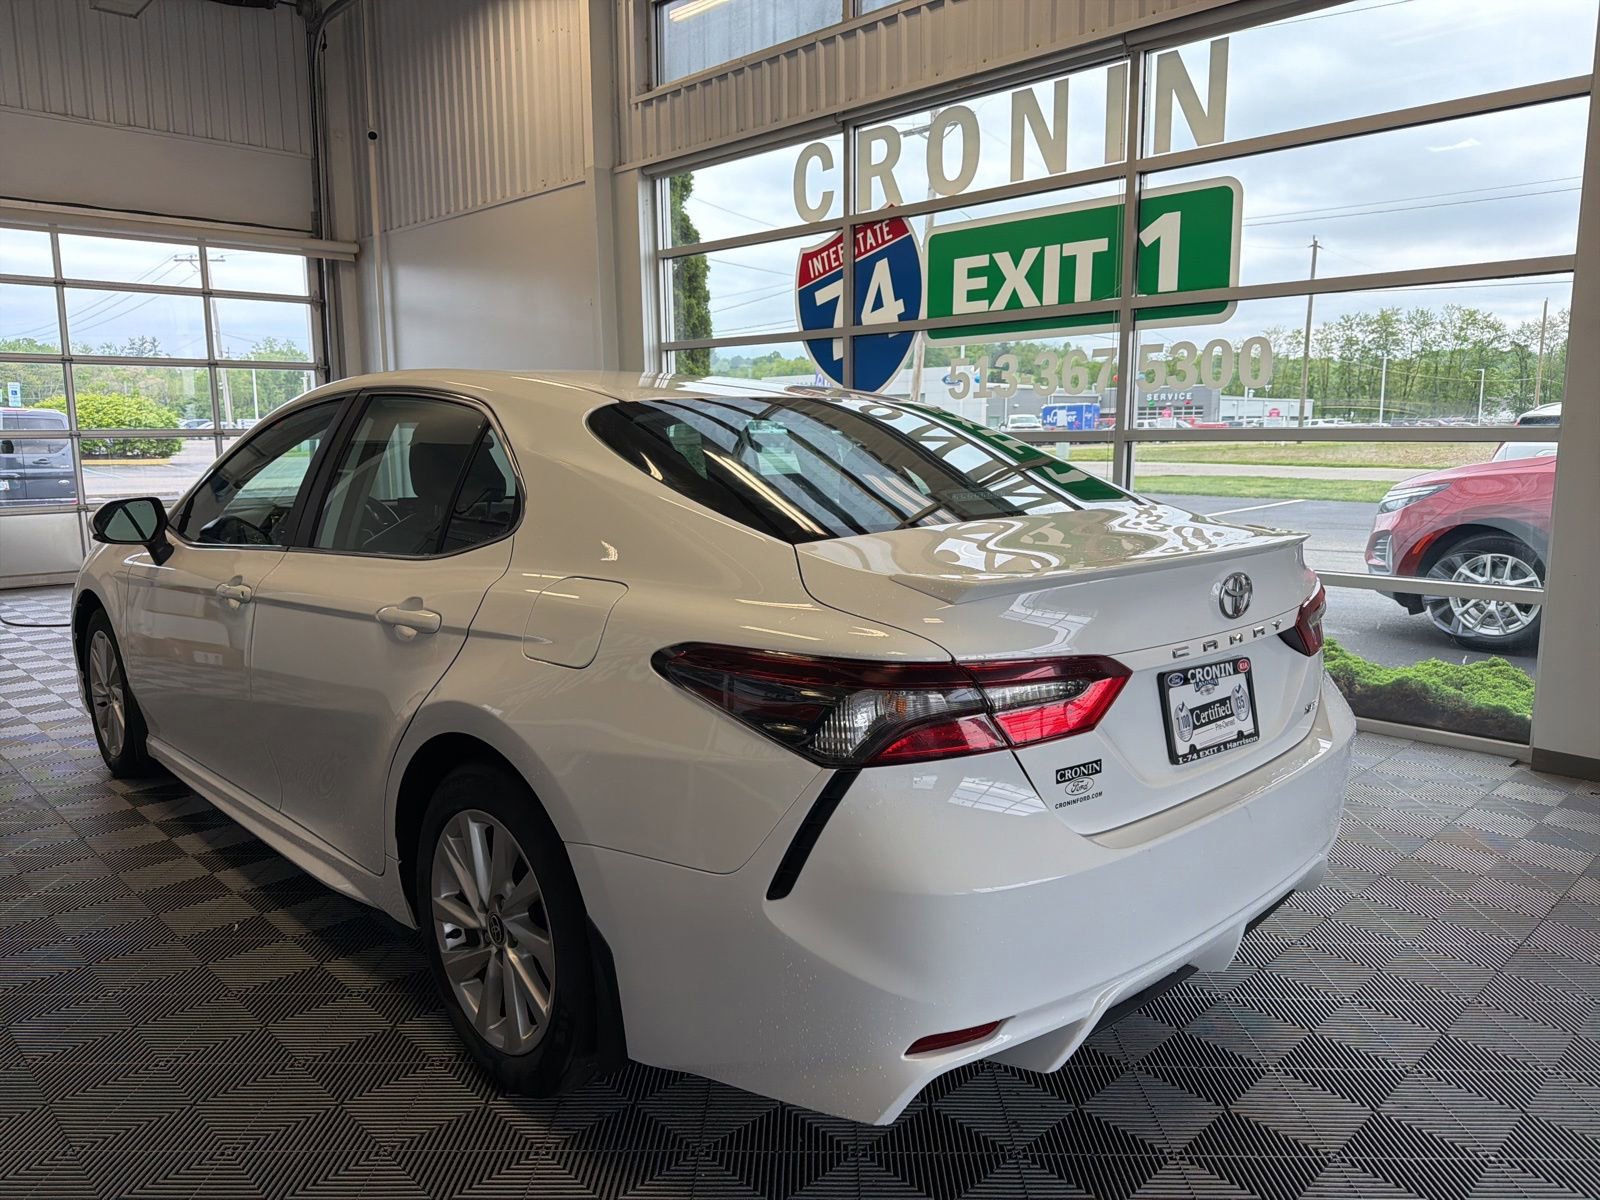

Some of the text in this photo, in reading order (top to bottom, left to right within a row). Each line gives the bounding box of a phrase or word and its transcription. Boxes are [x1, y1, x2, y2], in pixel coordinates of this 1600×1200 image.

[794, 36, 1230, 224] CRONIN
[808, 219, 894, 279] INTETATE
[952, 211, 1182, 315] EXIT 1
[814, 257, 906, 361] 74
[1146, 392, 1193, 401] SERVICE
[1046, 409, 1077, 424] Krer
[1172, 619, 1282, 659] CAMRY
[1187, 662, 1234, 684] CRONIN
[1193, 700, 1232, 726] Certified
[1178, 735, 1259, 765] I-74 EXIT 1 Harrison
[1057, 761, 1101, 782] CRONIN
[1070, 779, 1090, 793] Ford
[1055, 791, 1103, 809] CRONINFORD.COM
